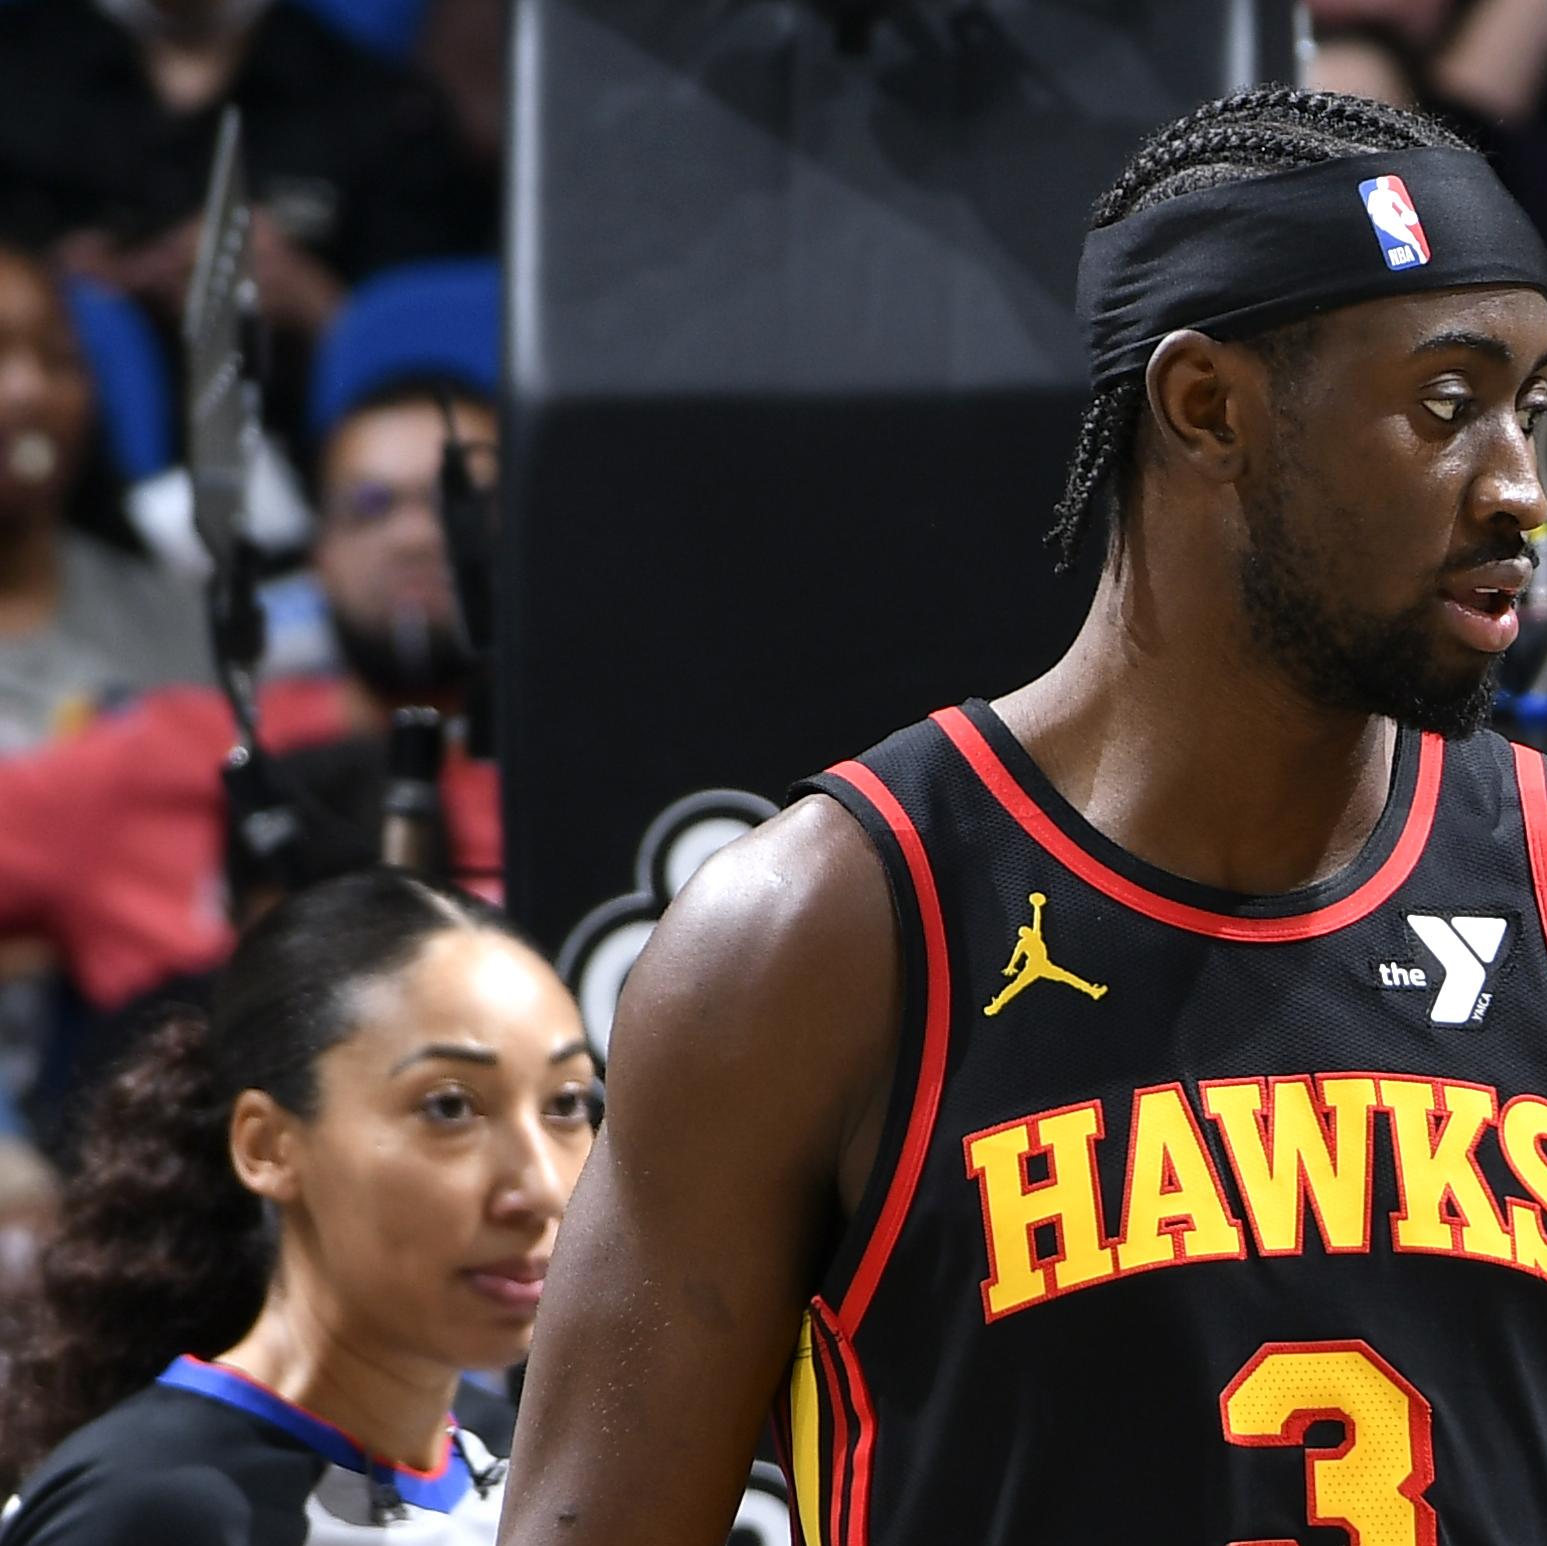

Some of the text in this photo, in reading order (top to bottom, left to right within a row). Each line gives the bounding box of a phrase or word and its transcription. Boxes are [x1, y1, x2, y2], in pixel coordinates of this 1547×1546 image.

[1387, 244, 1416, 266] NBA
[1378, 961, 1427, 987] the
[1471, 992, 1493, 1023] YMCA
